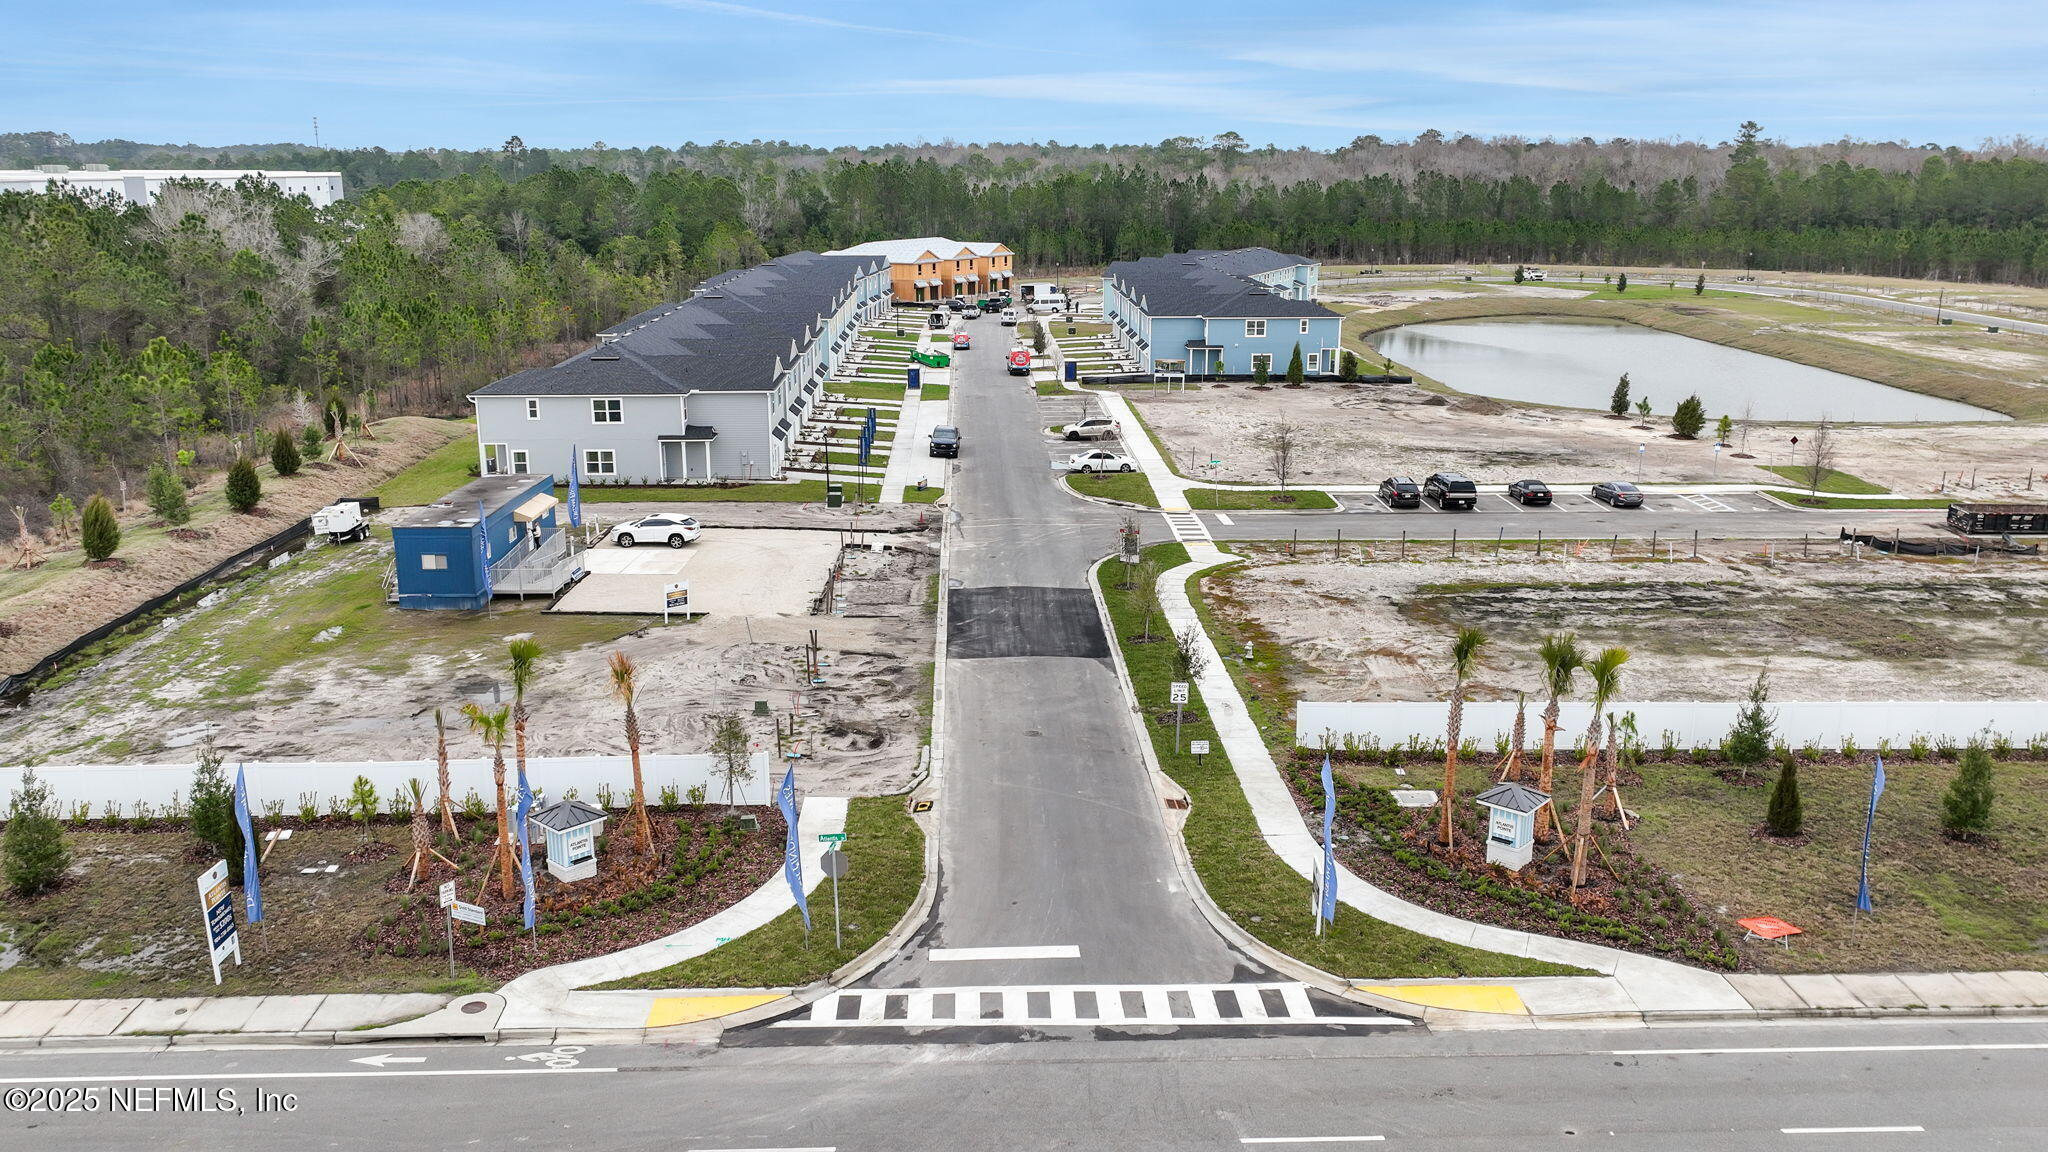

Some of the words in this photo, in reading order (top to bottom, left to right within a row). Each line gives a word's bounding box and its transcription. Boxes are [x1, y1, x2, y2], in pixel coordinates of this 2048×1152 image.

[1172, 693, 1187, 701] 25
[1495, 820, 1514, 829] ATLANTIS
[1496, 825, 1512, 833] POINTE
[570, 838, 589, 847] ATLANTIS
[572, 843, 587, 851] POINTE
